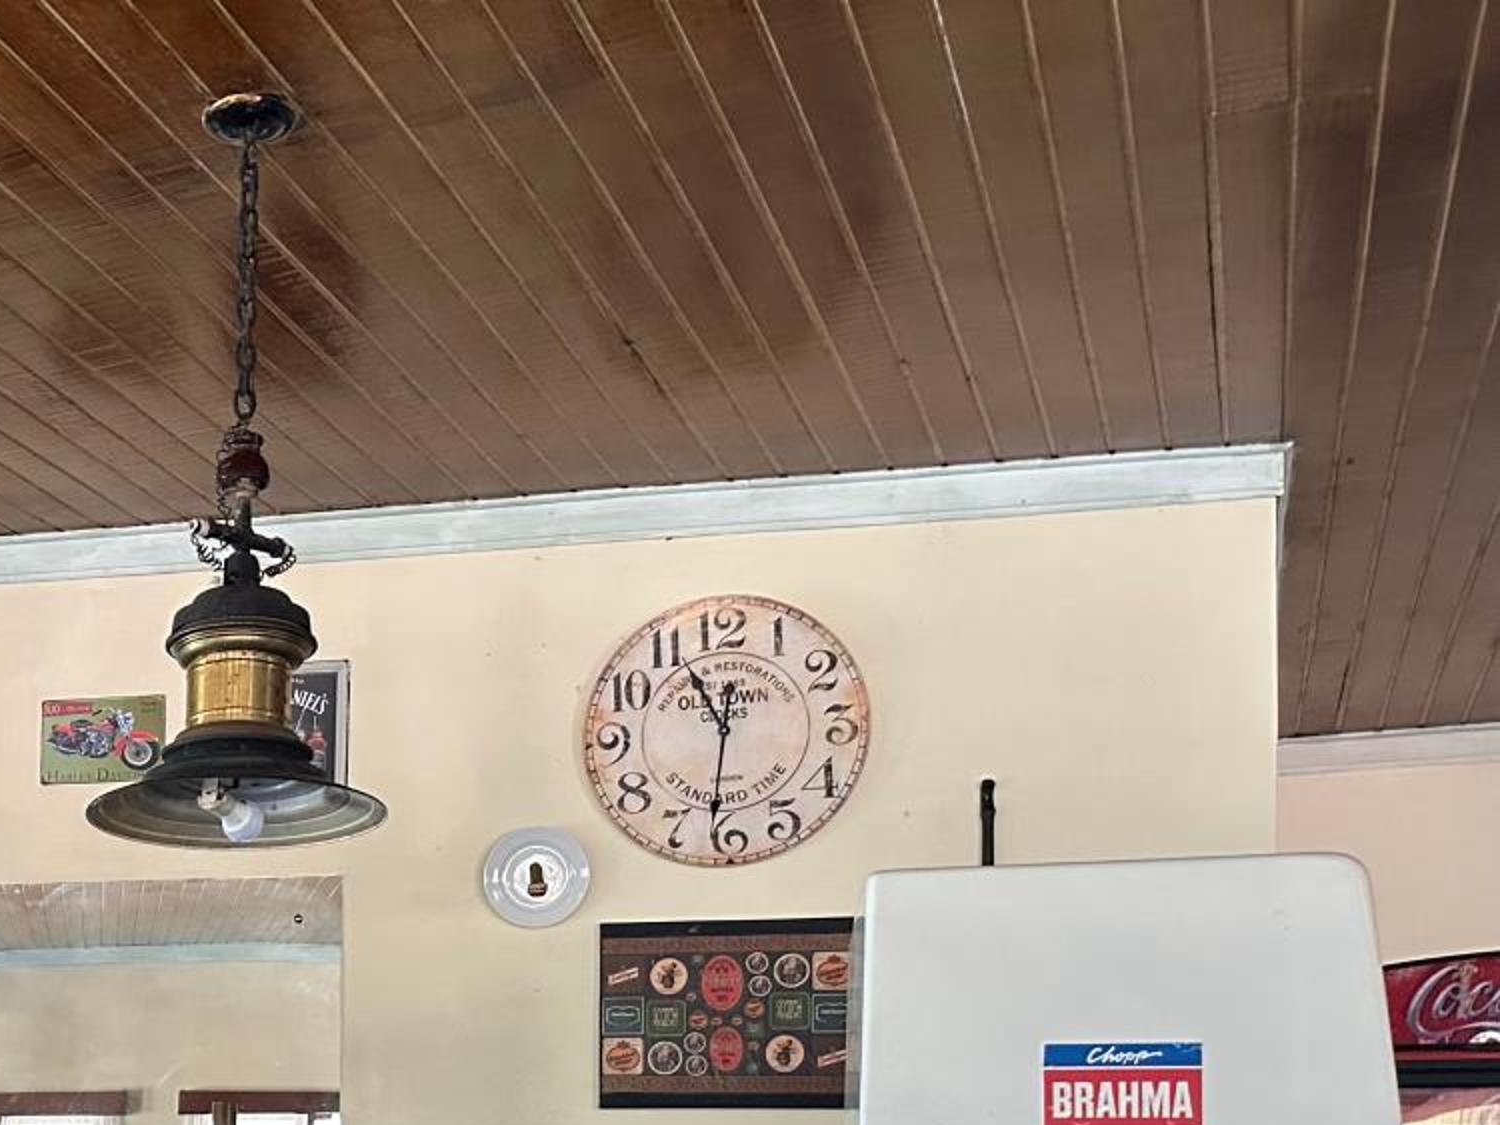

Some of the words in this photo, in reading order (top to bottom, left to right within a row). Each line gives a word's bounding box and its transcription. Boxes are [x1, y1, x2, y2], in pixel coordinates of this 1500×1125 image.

[652, 628, 680, 669] 11
[699, 607, 747, 652] 12
[772, 616, 785, 657] 1
[612, 669, 652, 713] 10
[714, 661, 796, 703] RESTORATIONS
[804, 648, 839, 693] 2
[596, 721, 631, 768] 9
[825, 703, 859, 746] 3
[617, 771, 652, 815] 8
[665, 771, 749, 805] STANDARD
[750, 762, 787, 795] TIME
[801, 756, 839, 799] 4
[661, 807, 693, 849] 7
[710, 809, 749, 855] 6
[768, 797, 802, 842] 5
[1086, 1046, 1163, 1065] Chopp
[1051, 1080, 1194, 1119] BRAHMA
